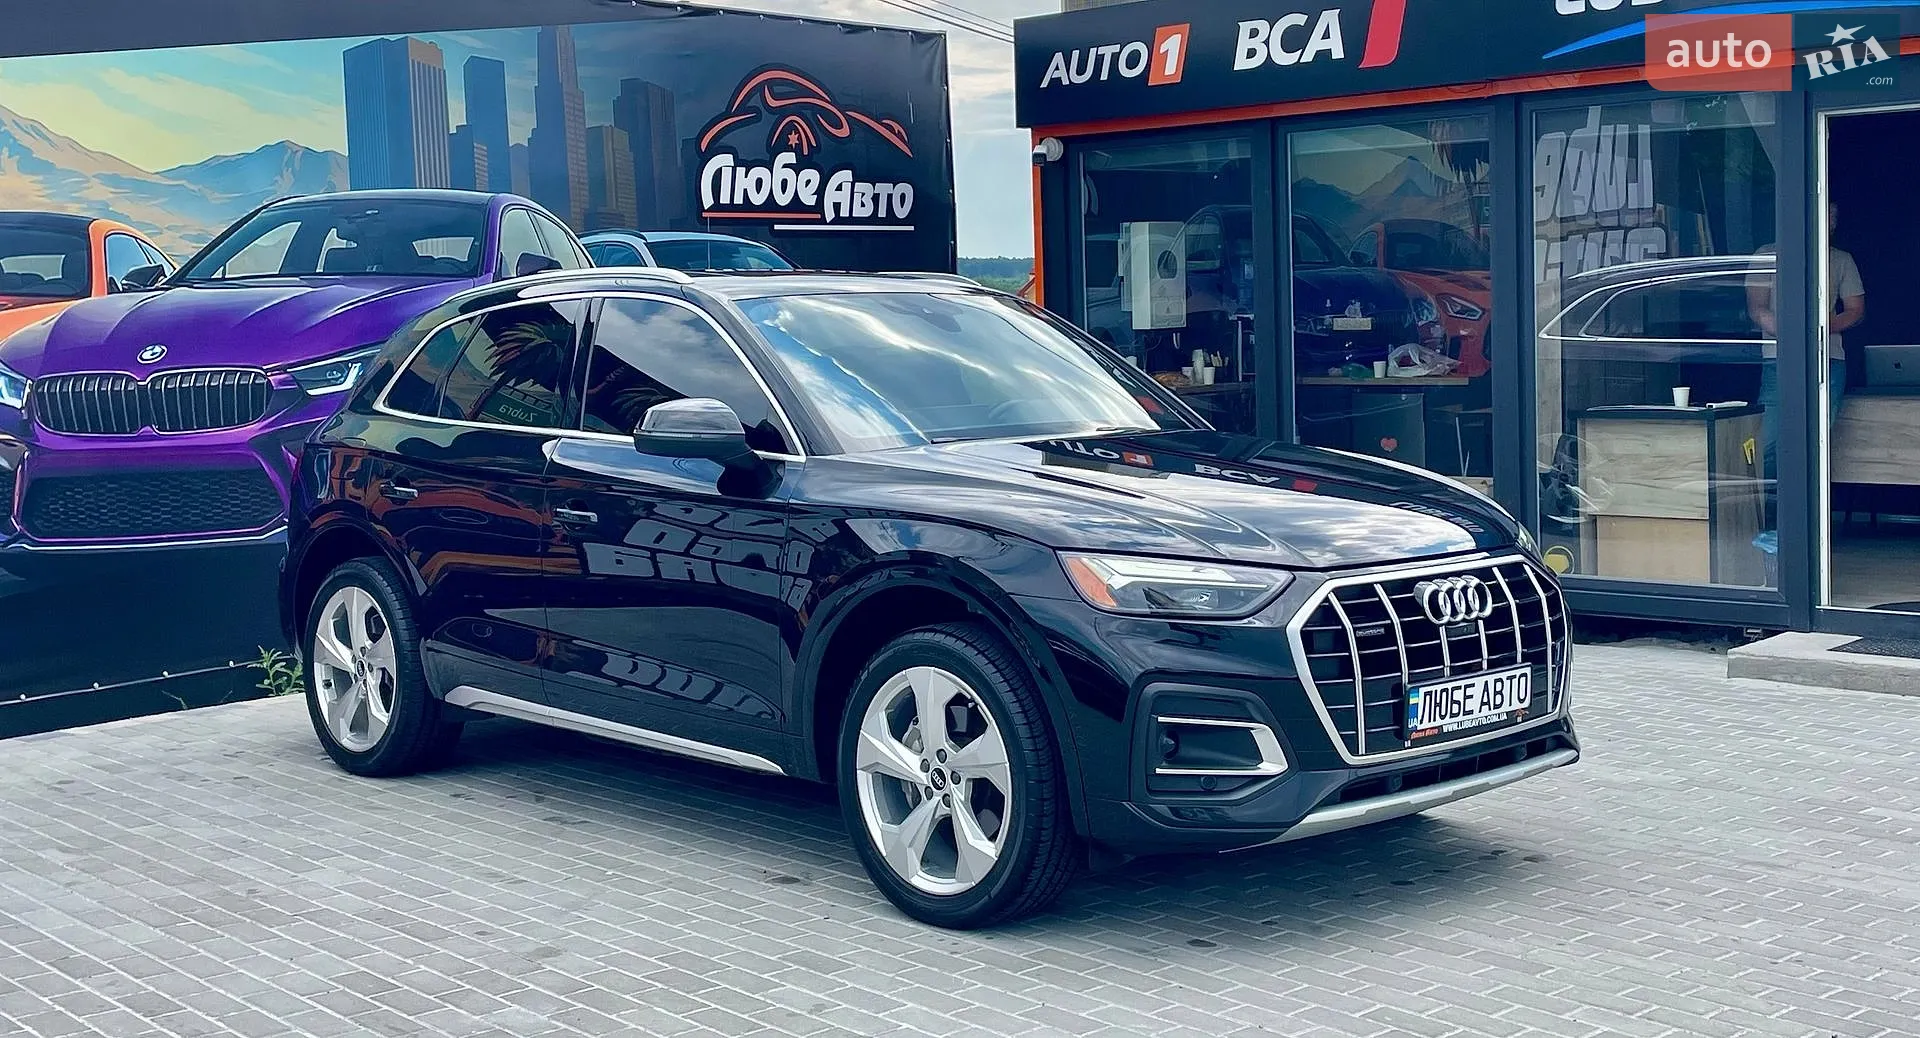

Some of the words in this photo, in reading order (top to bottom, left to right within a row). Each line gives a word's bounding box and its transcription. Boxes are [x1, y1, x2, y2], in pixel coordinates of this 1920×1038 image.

[1233, 8, 1345, 72] BCA
[1408, 718, 1418, 729] UA
[1419, 682, 1476, 725] ЛЮБЕ
[1478, 672, 1528, 713] АВТО
